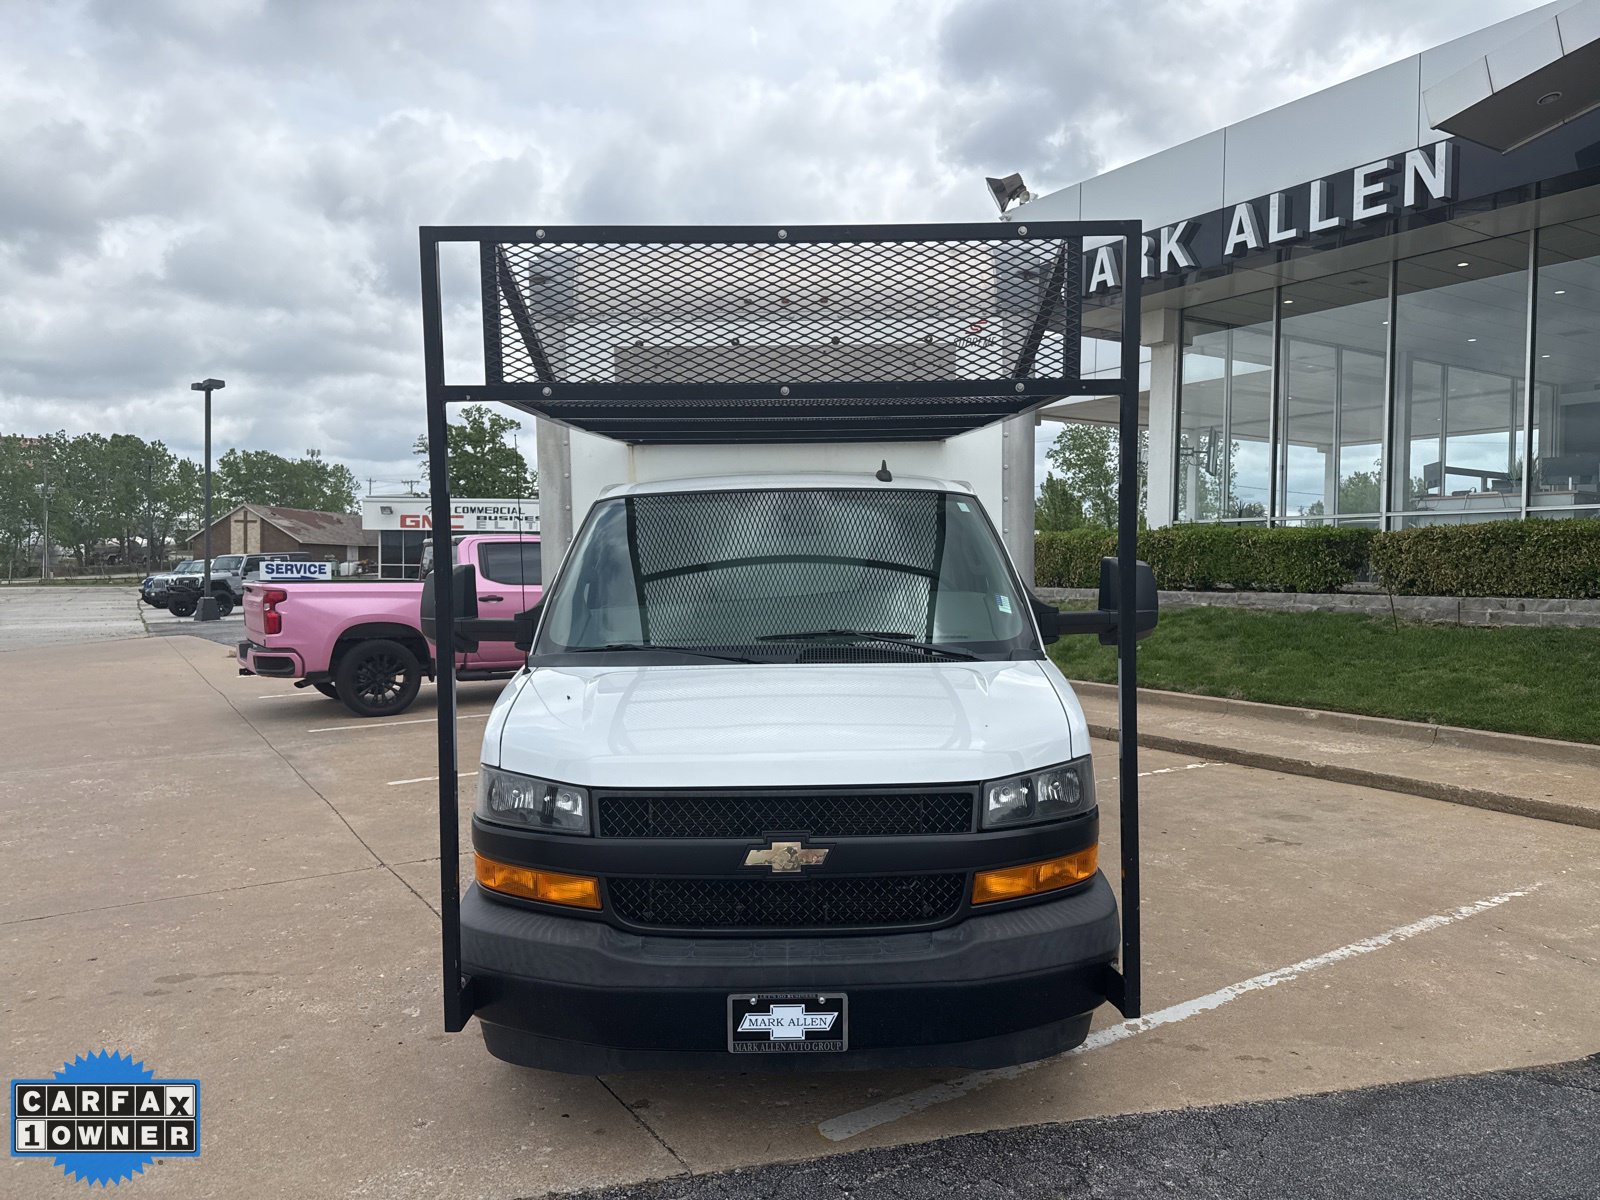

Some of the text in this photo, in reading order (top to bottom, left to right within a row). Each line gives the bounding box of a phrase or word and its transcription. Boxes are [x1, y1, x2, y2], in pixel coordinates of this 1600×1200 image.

[1224, 141, 1453, 256] ALLEN
[454, 506, 526, 515] COMMERCIAL
[265, 563, 327, 575] SERVICE
[748, 1017, 828, 1027] MARK ALLEN
[735, 1041, 842, 1052] MARK ALLEN AUTO GROUP
